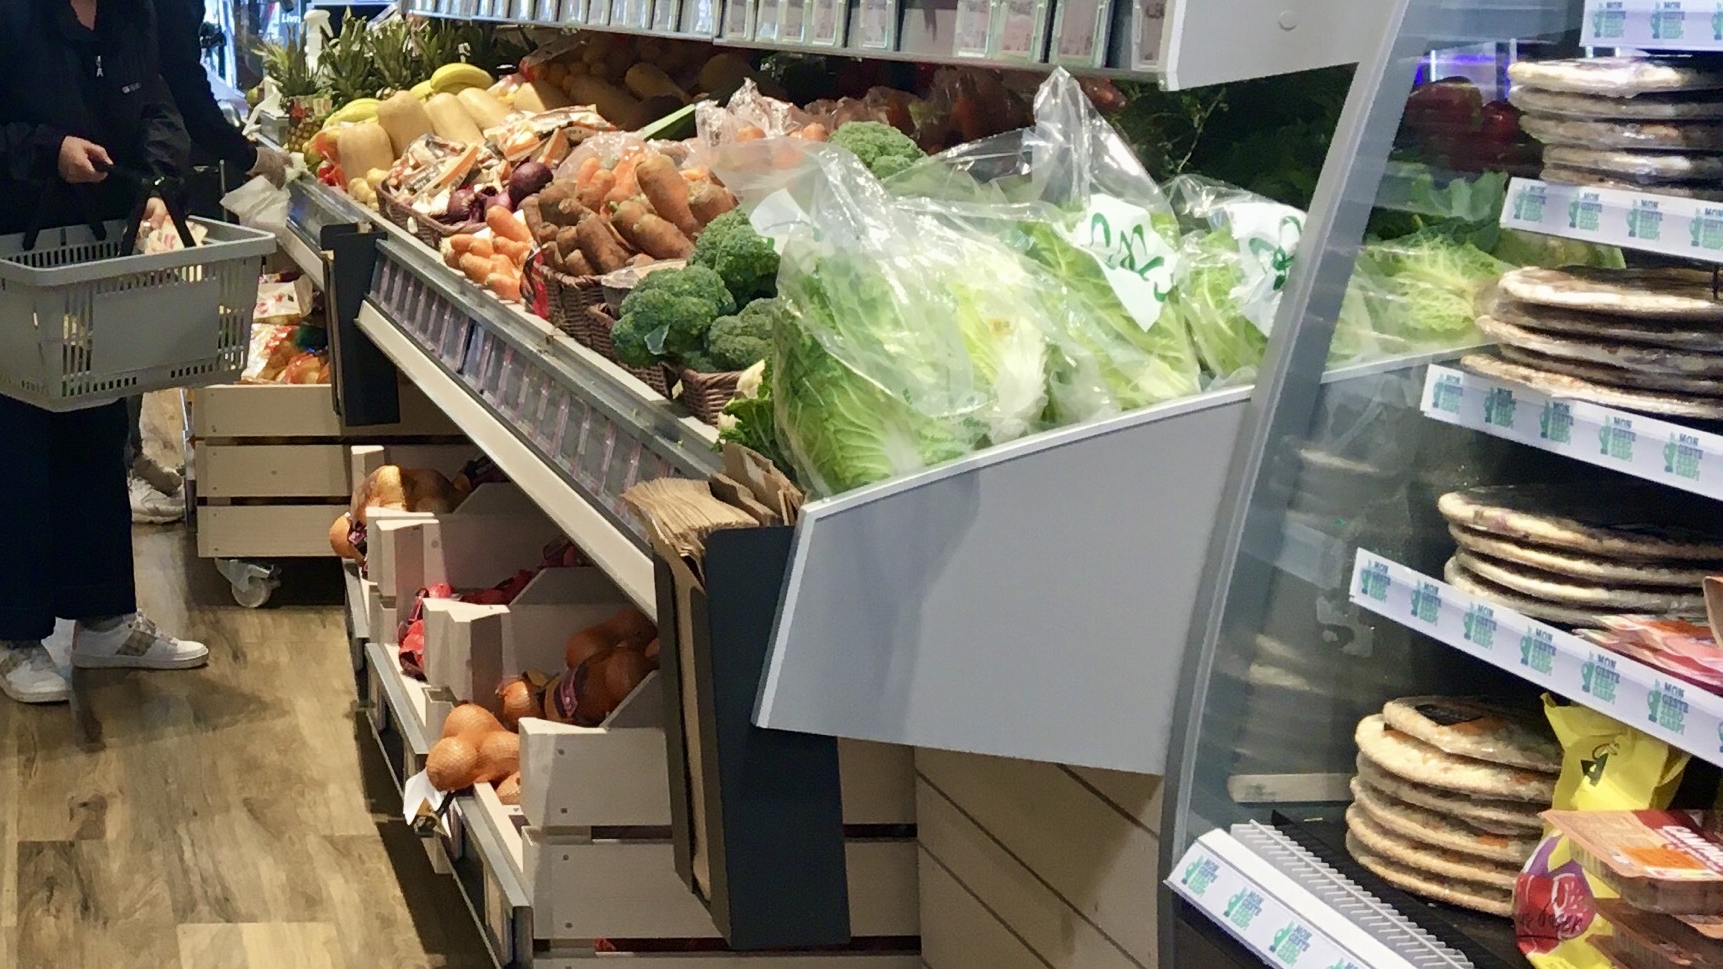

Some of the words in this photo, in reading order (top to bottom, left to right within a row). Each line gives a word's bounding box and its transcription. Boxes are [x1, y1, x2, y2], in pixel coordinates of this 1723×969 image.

[1536, 628, 1553, 642] MON
[1598, 654, 1616, 668] MON
[1664, 682, 1684, 698] MON
[1294, 925, 1313, 940] MON
